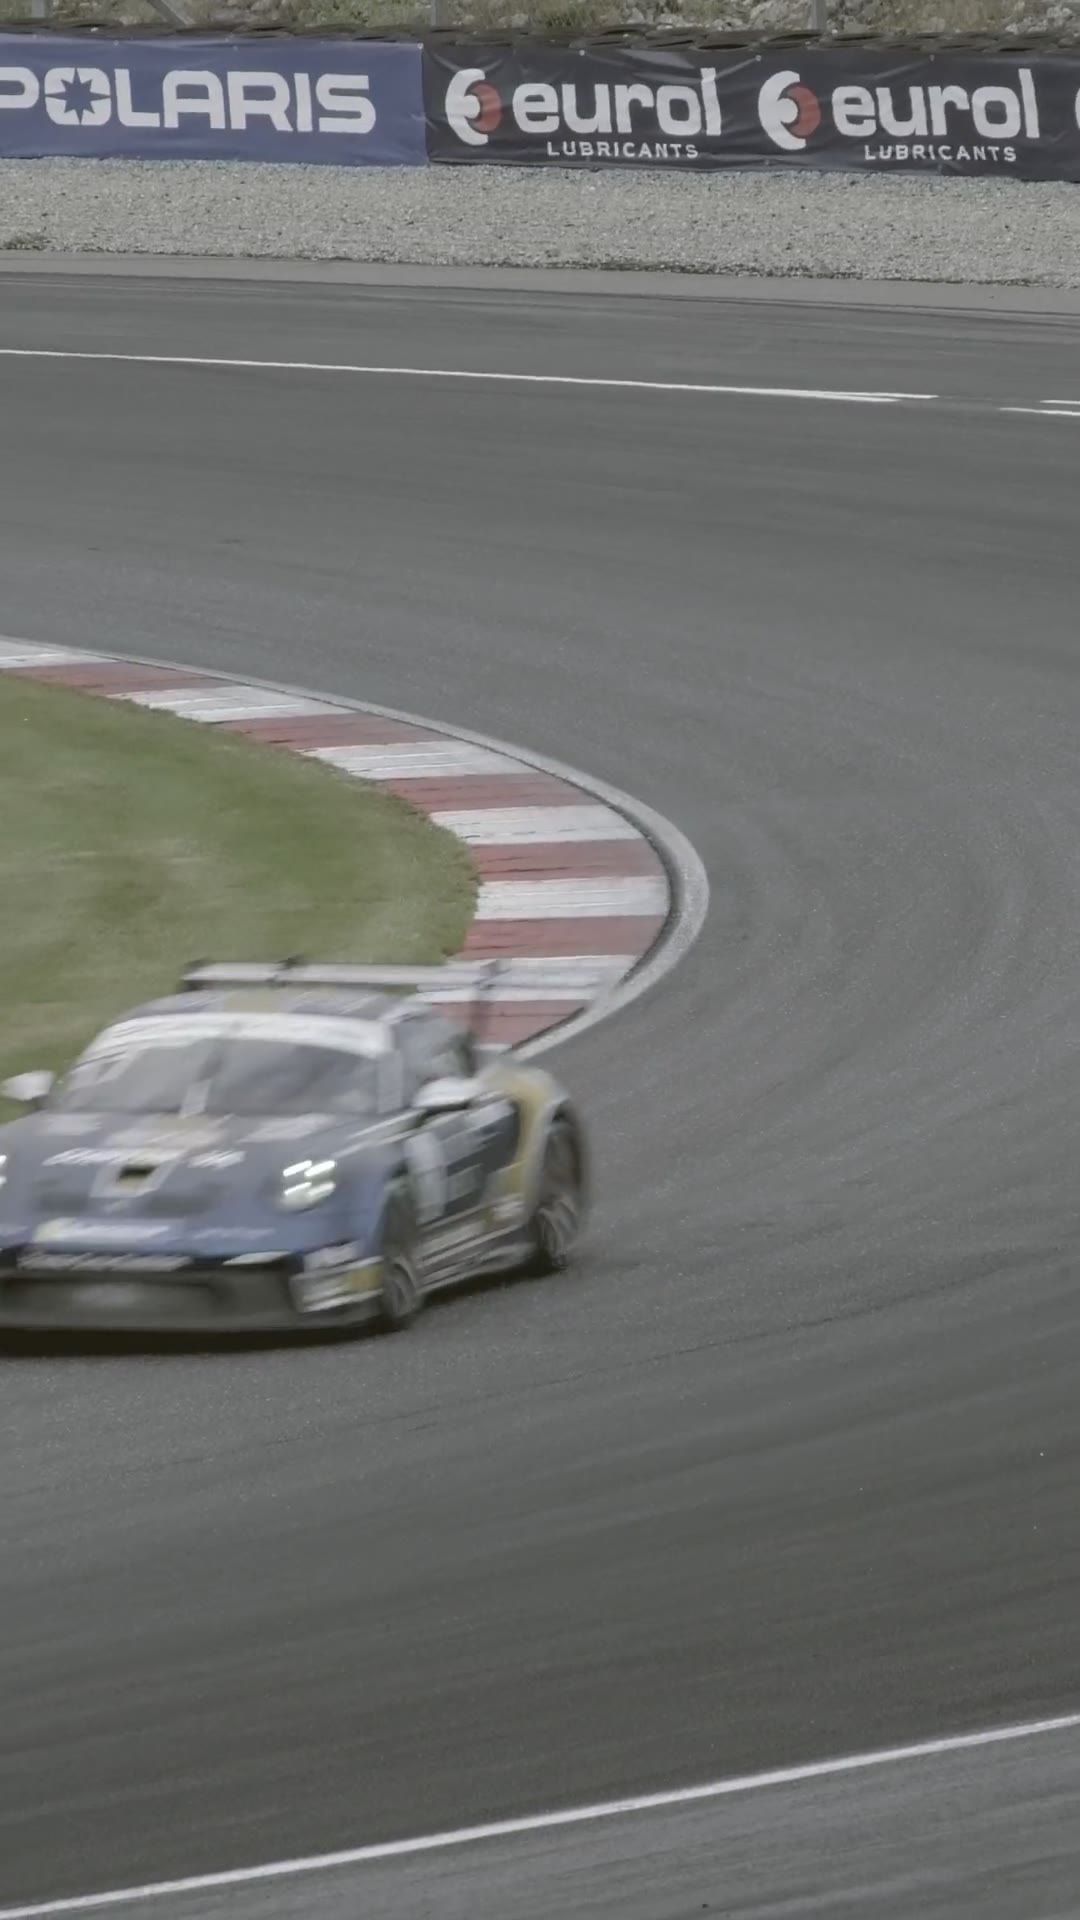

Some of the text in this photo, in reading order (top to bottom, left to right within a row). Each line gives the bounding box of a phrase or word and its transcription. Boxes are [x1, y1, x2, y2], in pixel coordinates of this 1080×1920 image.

[512, 67, 722, 136] eurol
[832, 68, 1039, 138] eurol
[547, 141, 699, 159] LUBRICANTS
[864, 144, 1017, 162] LUBRICANTS
